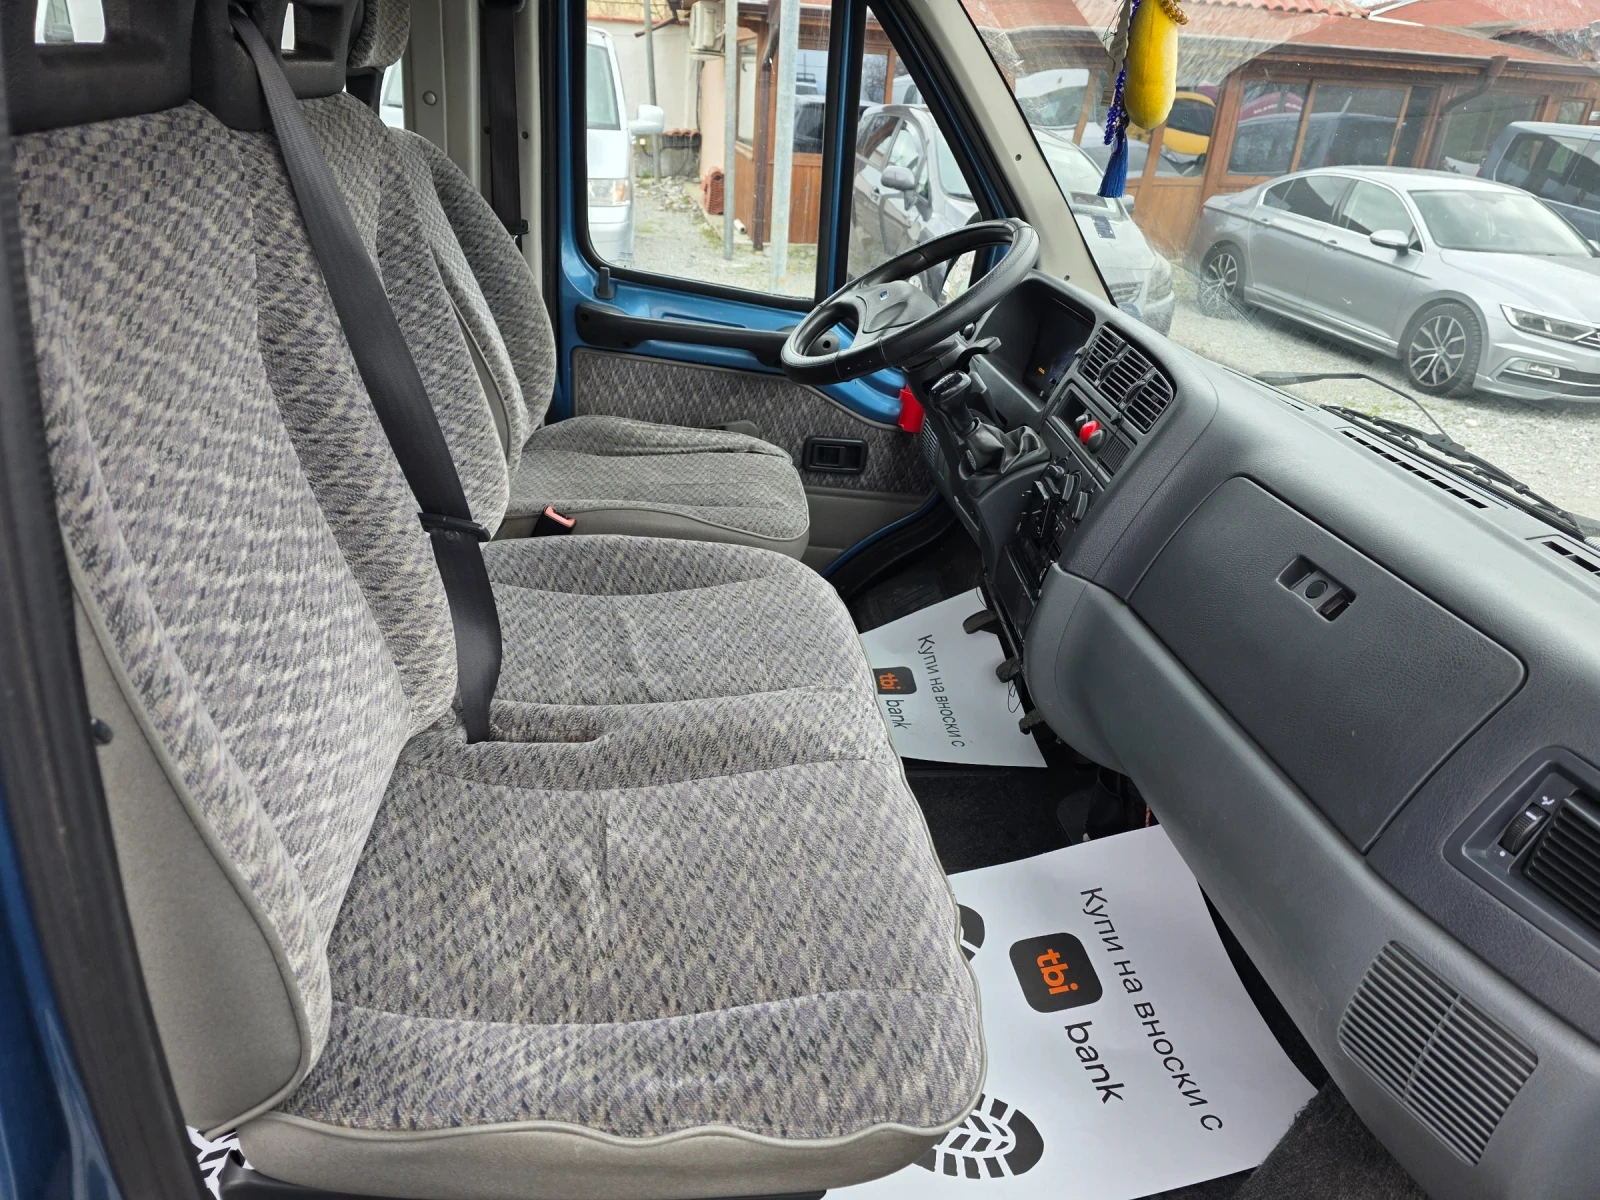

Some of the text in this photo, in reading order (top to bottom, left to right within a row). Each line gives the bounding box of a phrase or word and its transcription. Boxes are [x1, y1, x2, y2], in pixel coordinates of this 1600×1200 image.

[879, 673, 901, 690] tbi
[918, 634, 966, 748] Купи на вноски с
[885, 699, 912, 730] bank
[1036, 948, 1079, 995] tbi
[1080, 887, 1223, 1131] Купи на вноски с
[1065, 1021, 1124, 1104] bank
